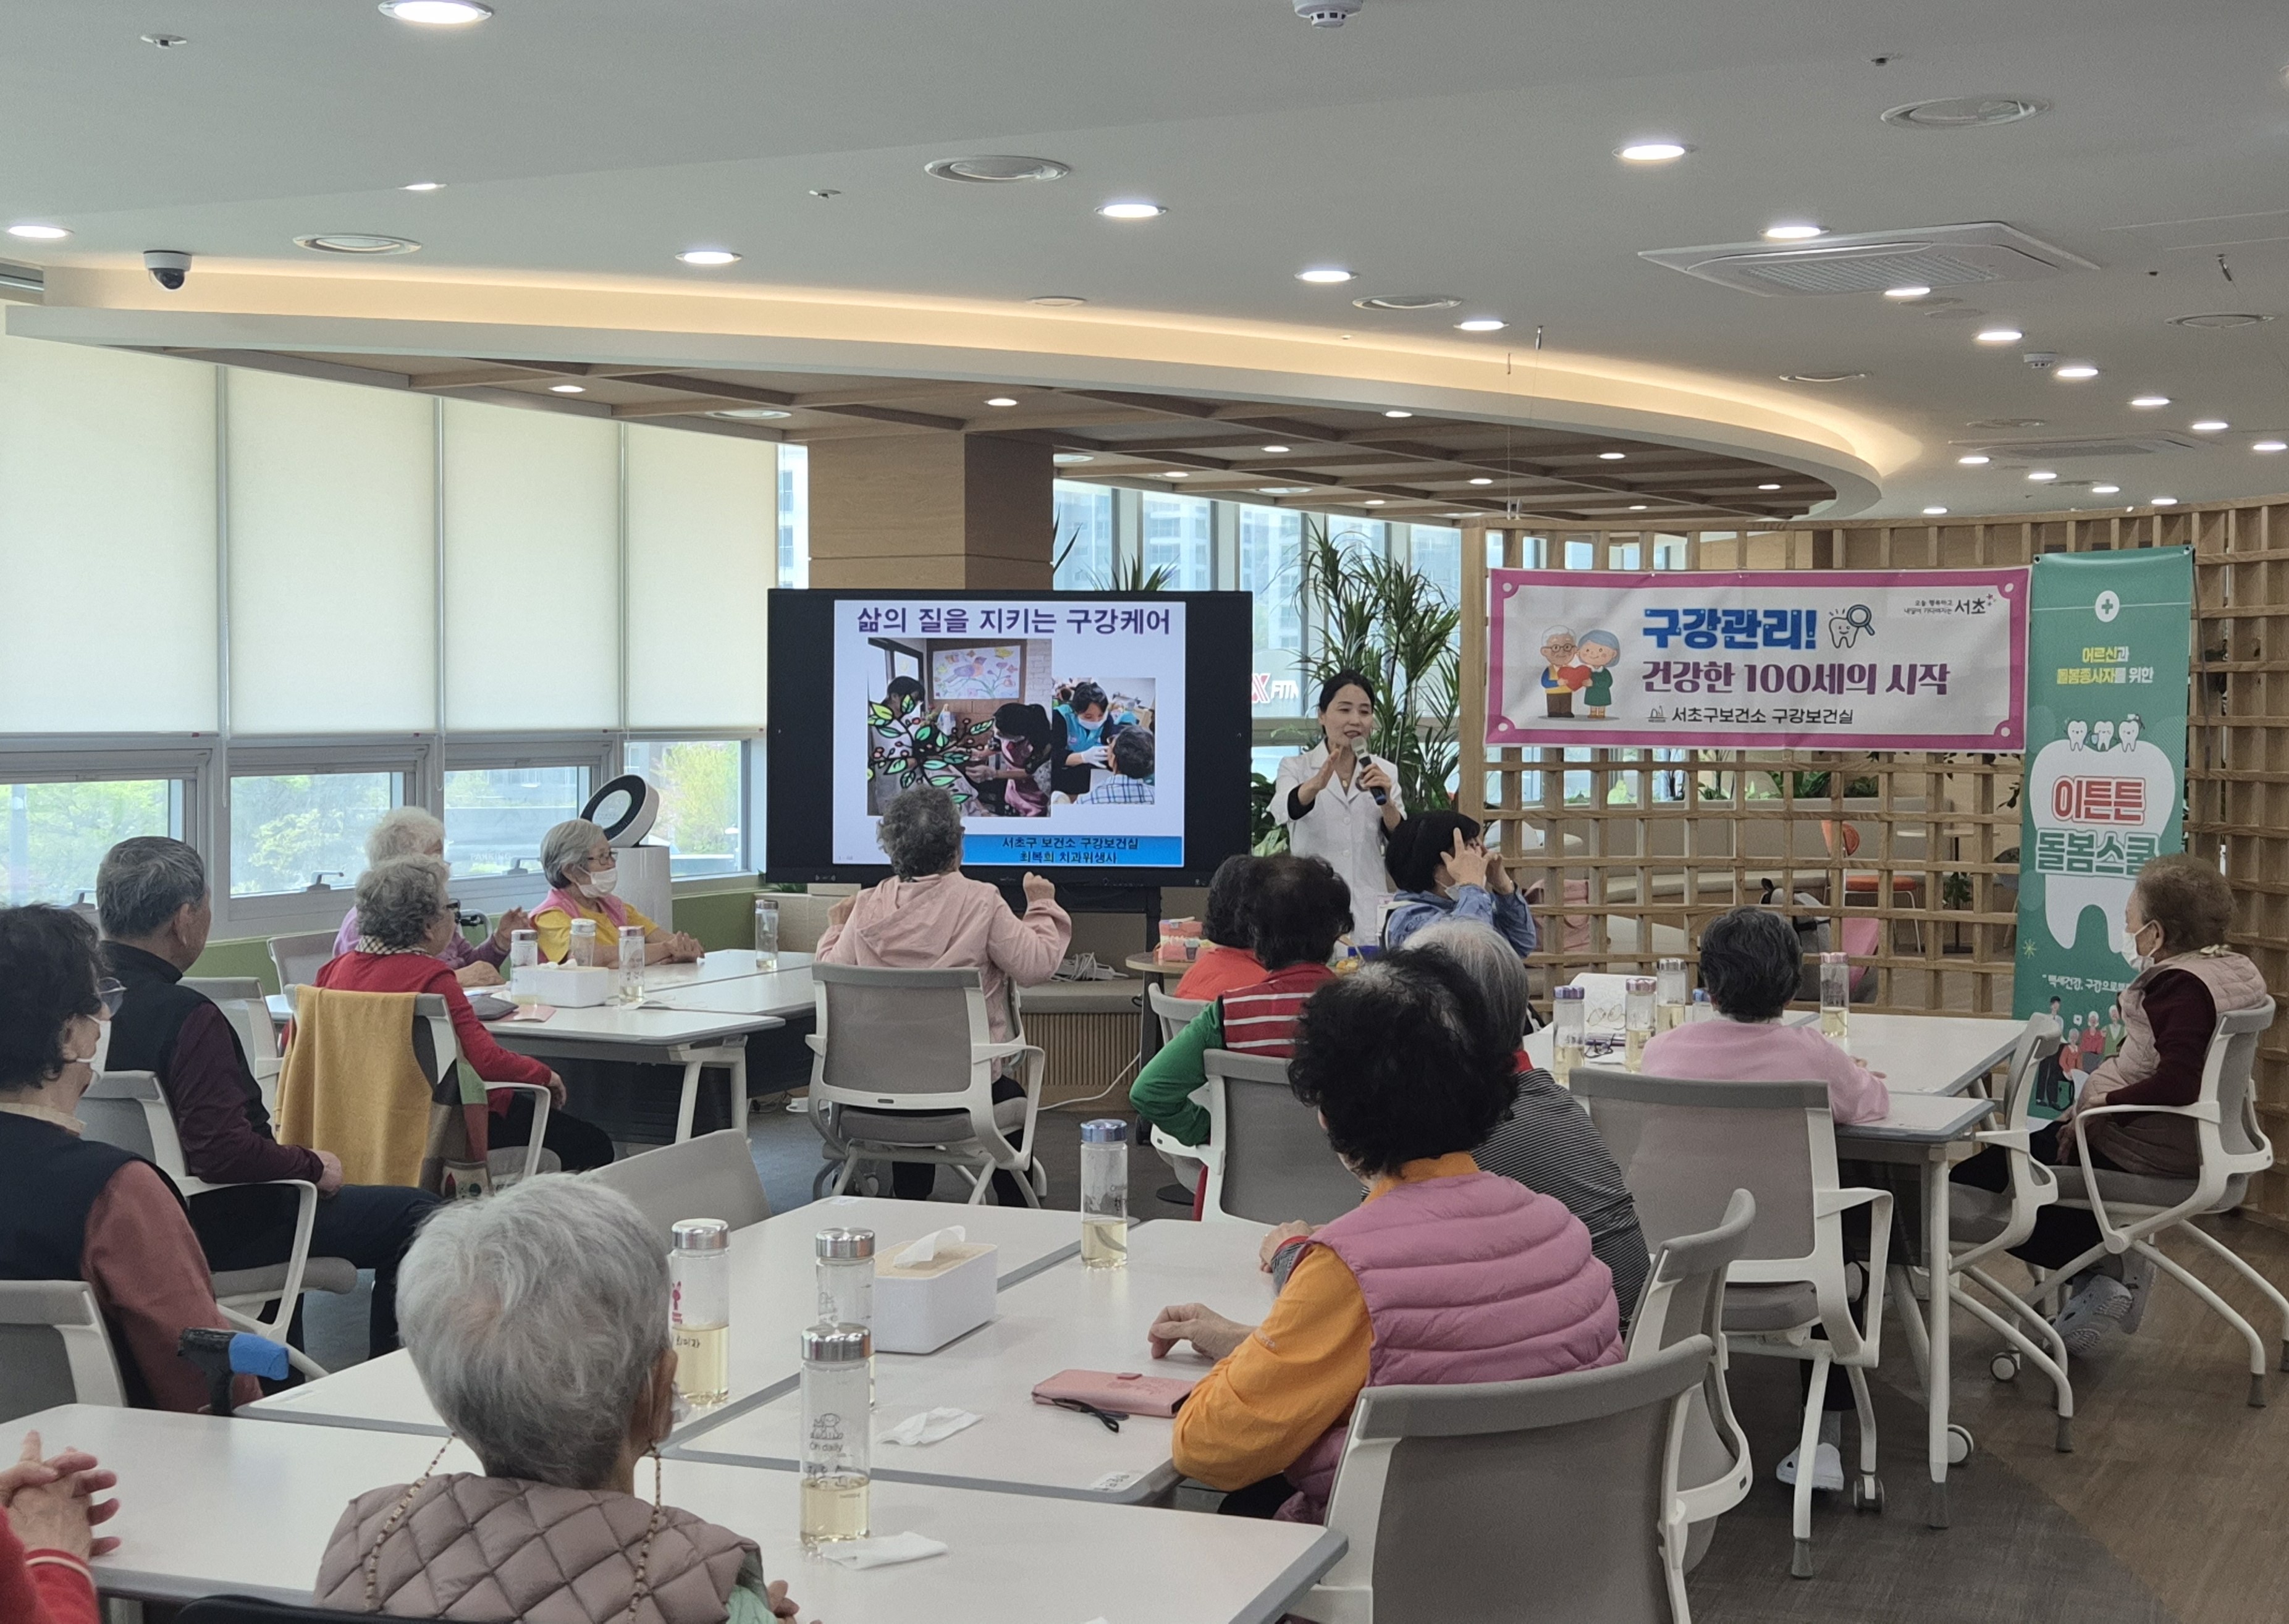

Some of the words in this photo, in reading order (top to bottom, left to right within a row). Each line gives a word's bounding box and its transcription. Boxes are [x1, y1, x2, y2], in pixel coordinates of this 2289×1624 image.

[1955, 598, 1986, 615] 서초
[857, 607, 906, 634] 삶의
[918, 607, 969, 634] 질을
[979, 608, 1056, 634] 지키는
[1066, 608, 1170, 635] 구강케어
[1643, 608, 1817, 649] 구강관리!
[2081, 646, 2129, 663] 어르신과
[1642, 661, 1735, 693] 건강한
[1743, 663, 1877, 694] 100세의
[1885, 663, 1950, 694] 시작
[2129, 667, 2154, 683] 위한
[1672, 707, 1766, 723] 서초구보건소
[1772, 708, 1853, 724] 구강보건실
[2054, 778, 2144, 825] 이튼튼
[1002, 837, 1037, 849] 서초구
[1042, 837, 1076, 849] 보건소
[1081, 838, 1139, 849] 구강보건실
[1060, 851, 1117, 864] 치과위생사
[2038, 831, 2158, 877] 돌봄스쿨
